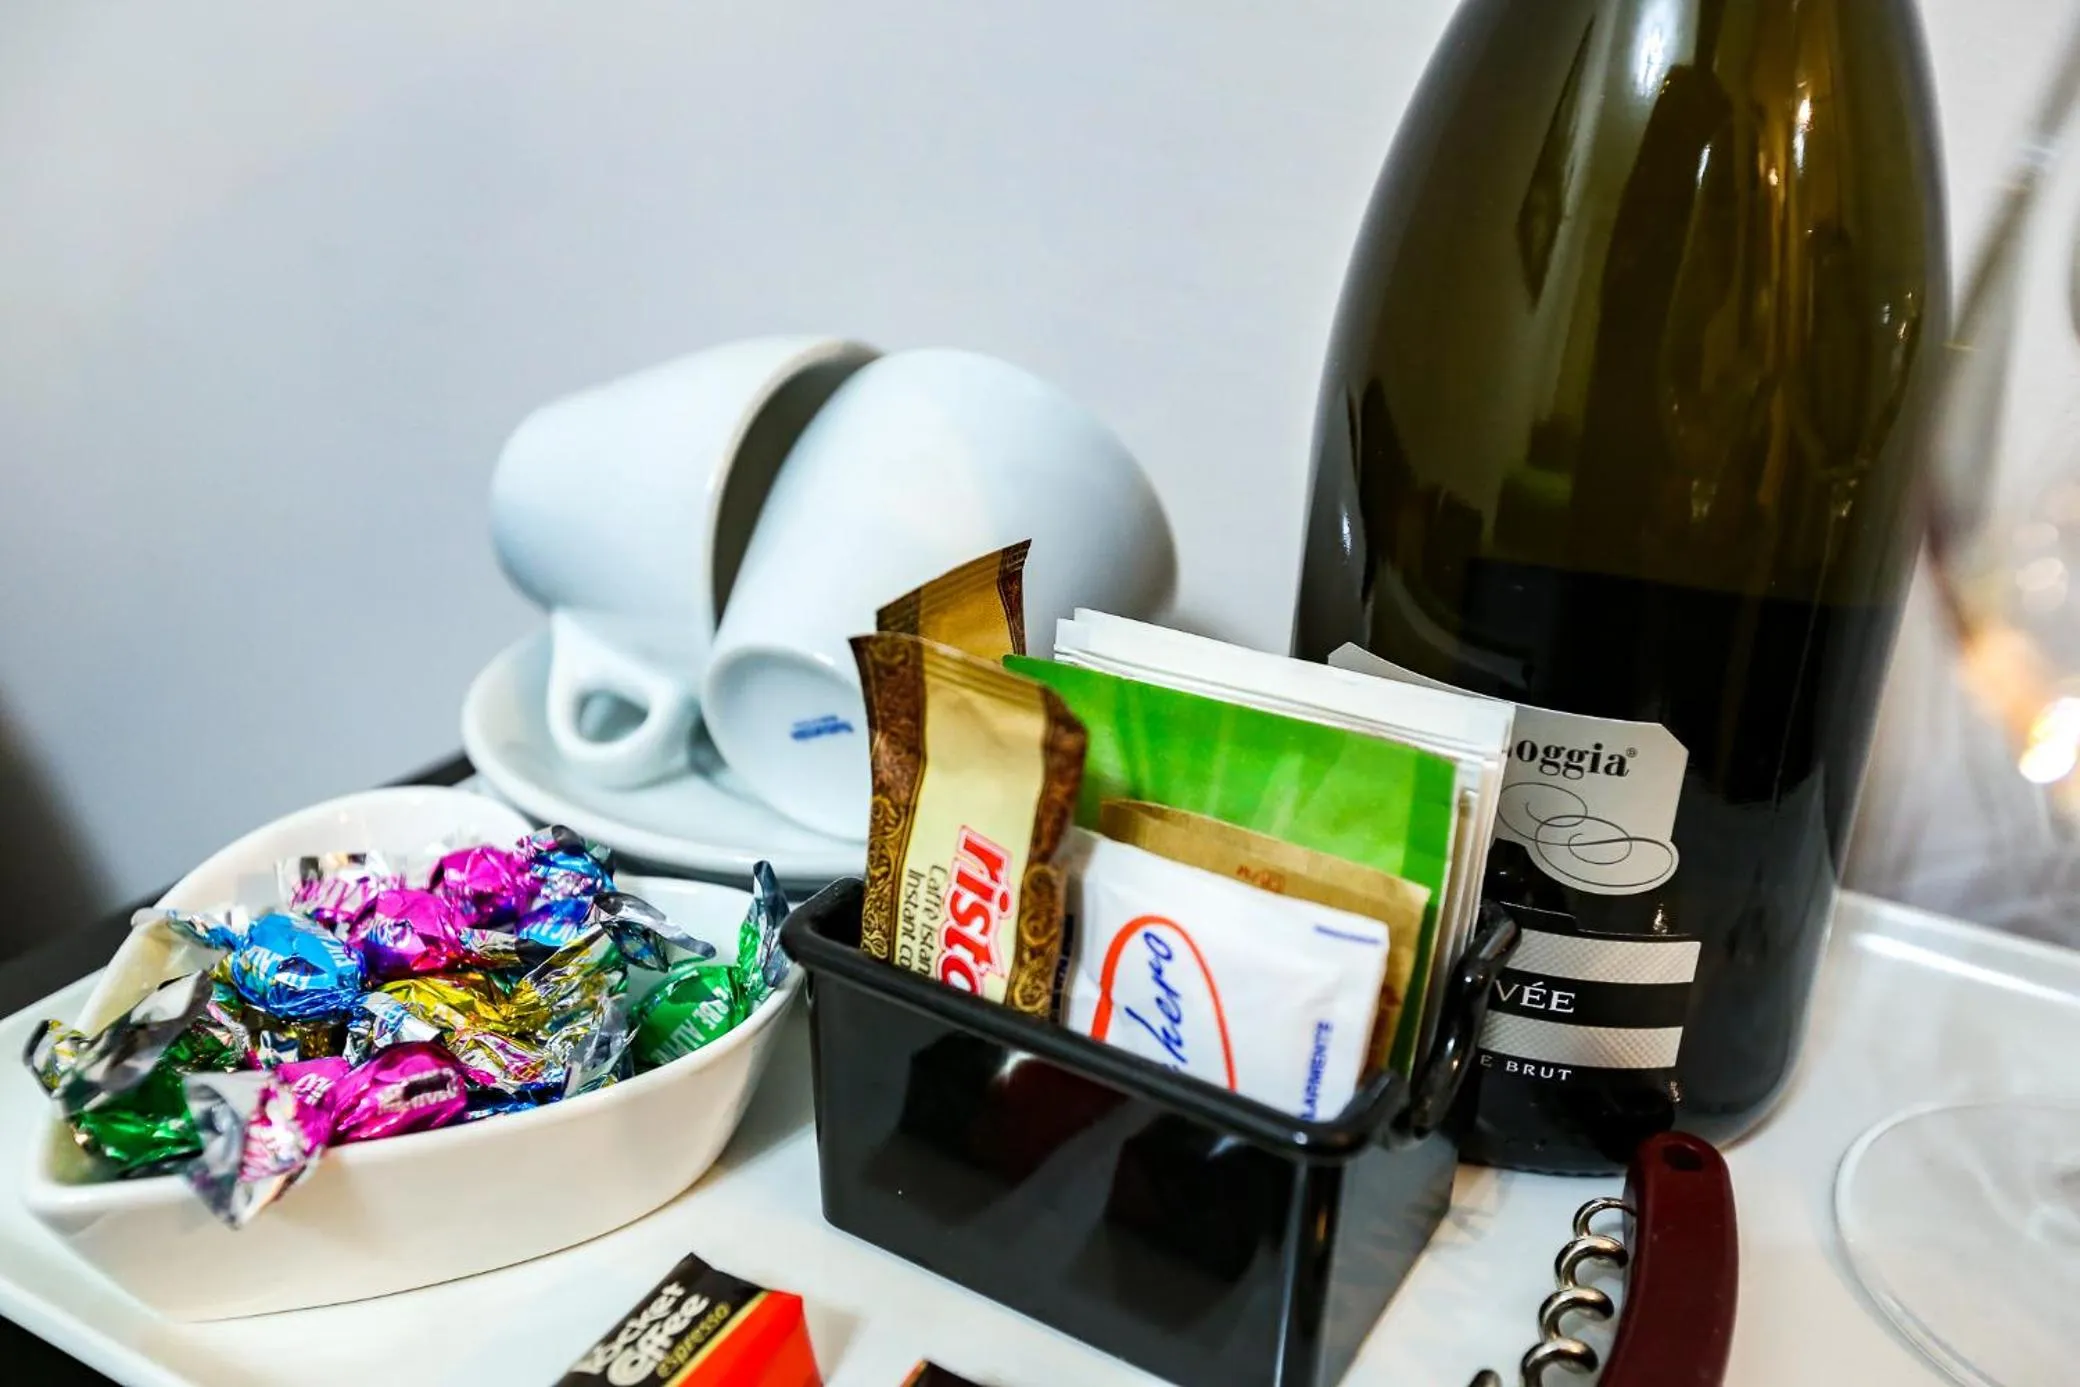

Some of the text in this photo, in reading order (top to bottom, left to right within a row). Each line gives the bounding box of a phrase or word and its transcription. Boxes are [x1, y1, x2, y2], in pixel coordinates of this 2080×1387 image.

[1507, 740, 1630, 780] oggia
[900, 868, 925, 942] Instant
[1505, 1060, 1572, 1081] BRUT
[656, 1302, 731, 1378] espresso
